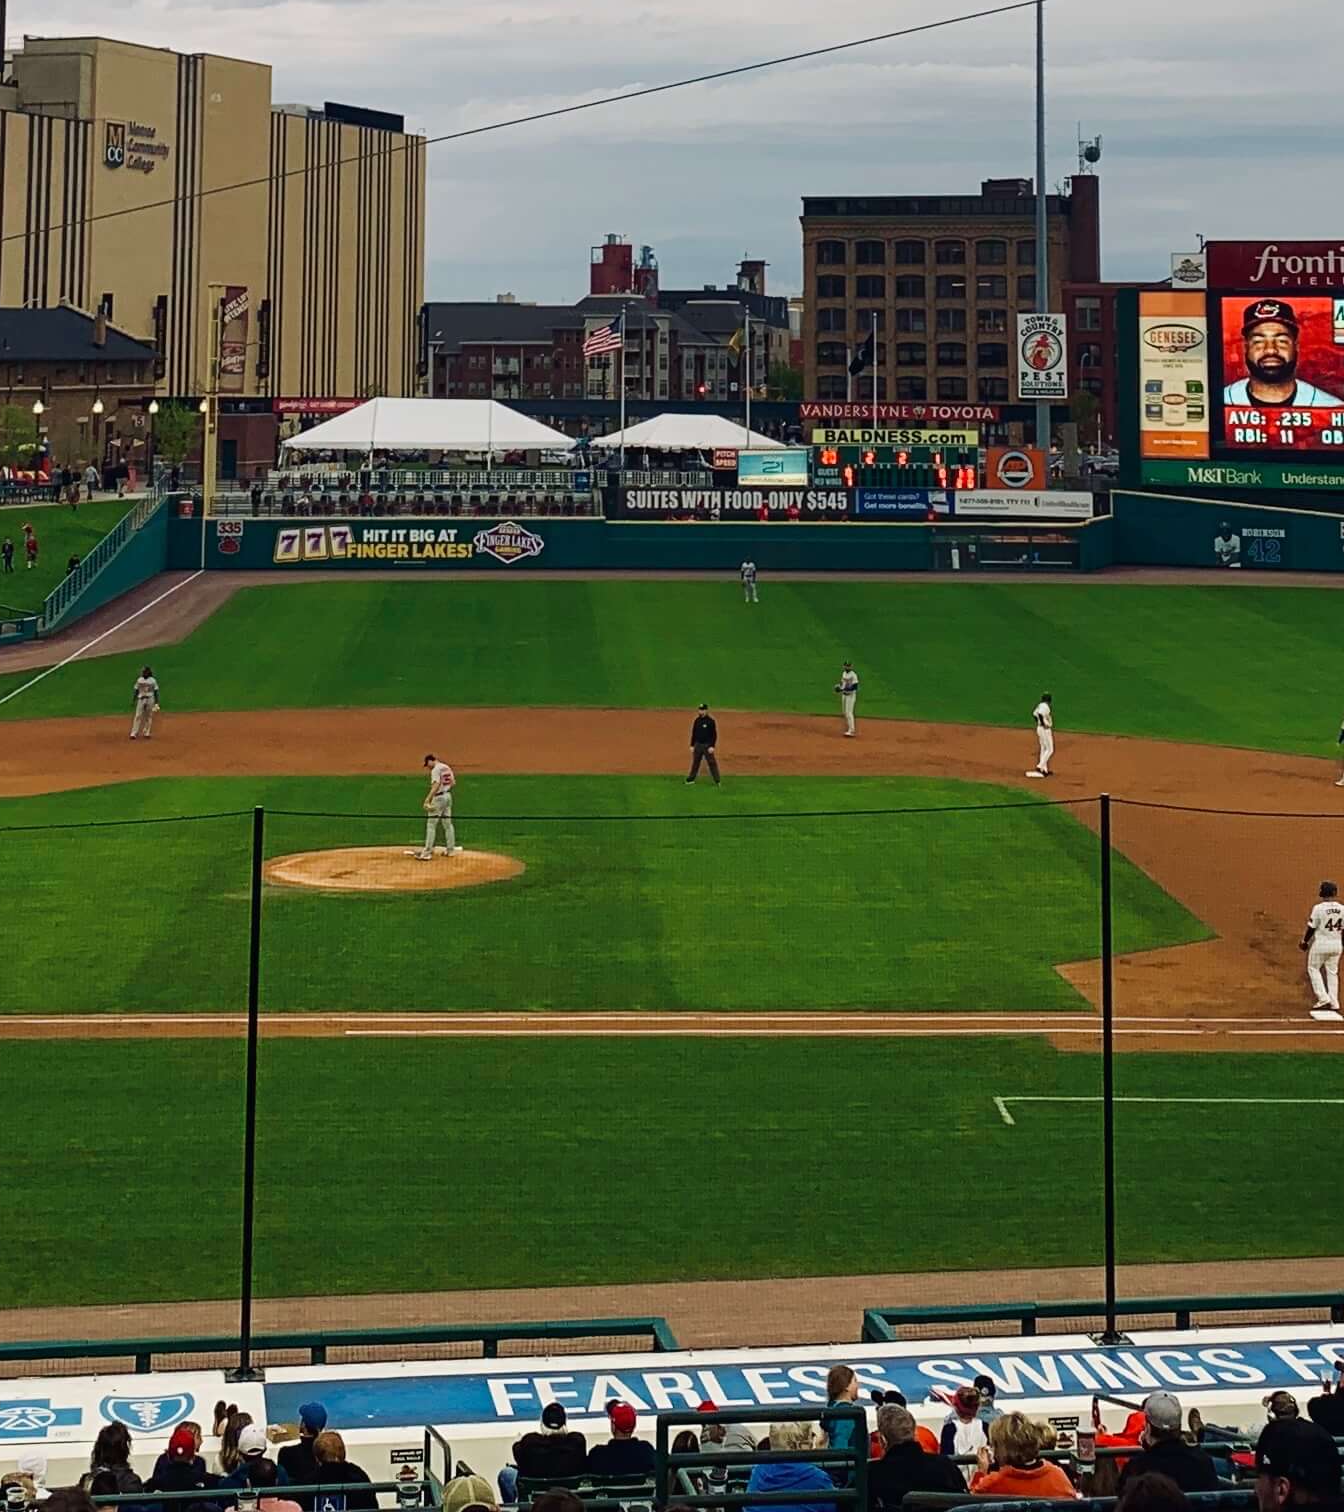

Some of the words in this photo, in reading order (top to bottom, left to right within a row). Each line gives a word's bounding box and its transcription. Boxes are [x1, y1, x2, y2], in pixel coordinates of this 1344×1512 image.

[1024, 316, 1050, 325] TOWN
[1020, 323, 1064, 337] COUNTRY
[1150, 331, 1197, 344] GENESEE
[1021, 372, 1064, 381] PEST
[930, 406, 994, 418] TOYOTA
[1229, 411, 1266, 425] AVG:
[1275, 412, 1312, 426] .235
[824, 430, 966, 444] BALDNESS.com
[1234, 429, 1268, 443] RBI:
[626, 491, 679, 509] SUITES
[681, 491, 721, 509] WITH
[724, 491, 804, 509] FOOD-ONLY
[807, 491, 847, 510] $545
[218, 522, 242, 534] 335
[363, 529, 389, 542] HIT
[391, 529, 407, 542] IT
[409, 529, 435, 542] BIG
[438, 529, 458, 542] AT
[479, 531, 511, 552] FINGER
[347, 544, 409, 558] FINGER
[412, 544, 473, 558] LAKES!
[1246, 539, 1281, 564] 42
[1324, 917, 1343, 932] 44
[485, 1363, 903, 1417] FEARLESS
[917, 1347, 1267, 1393] SWINGS
